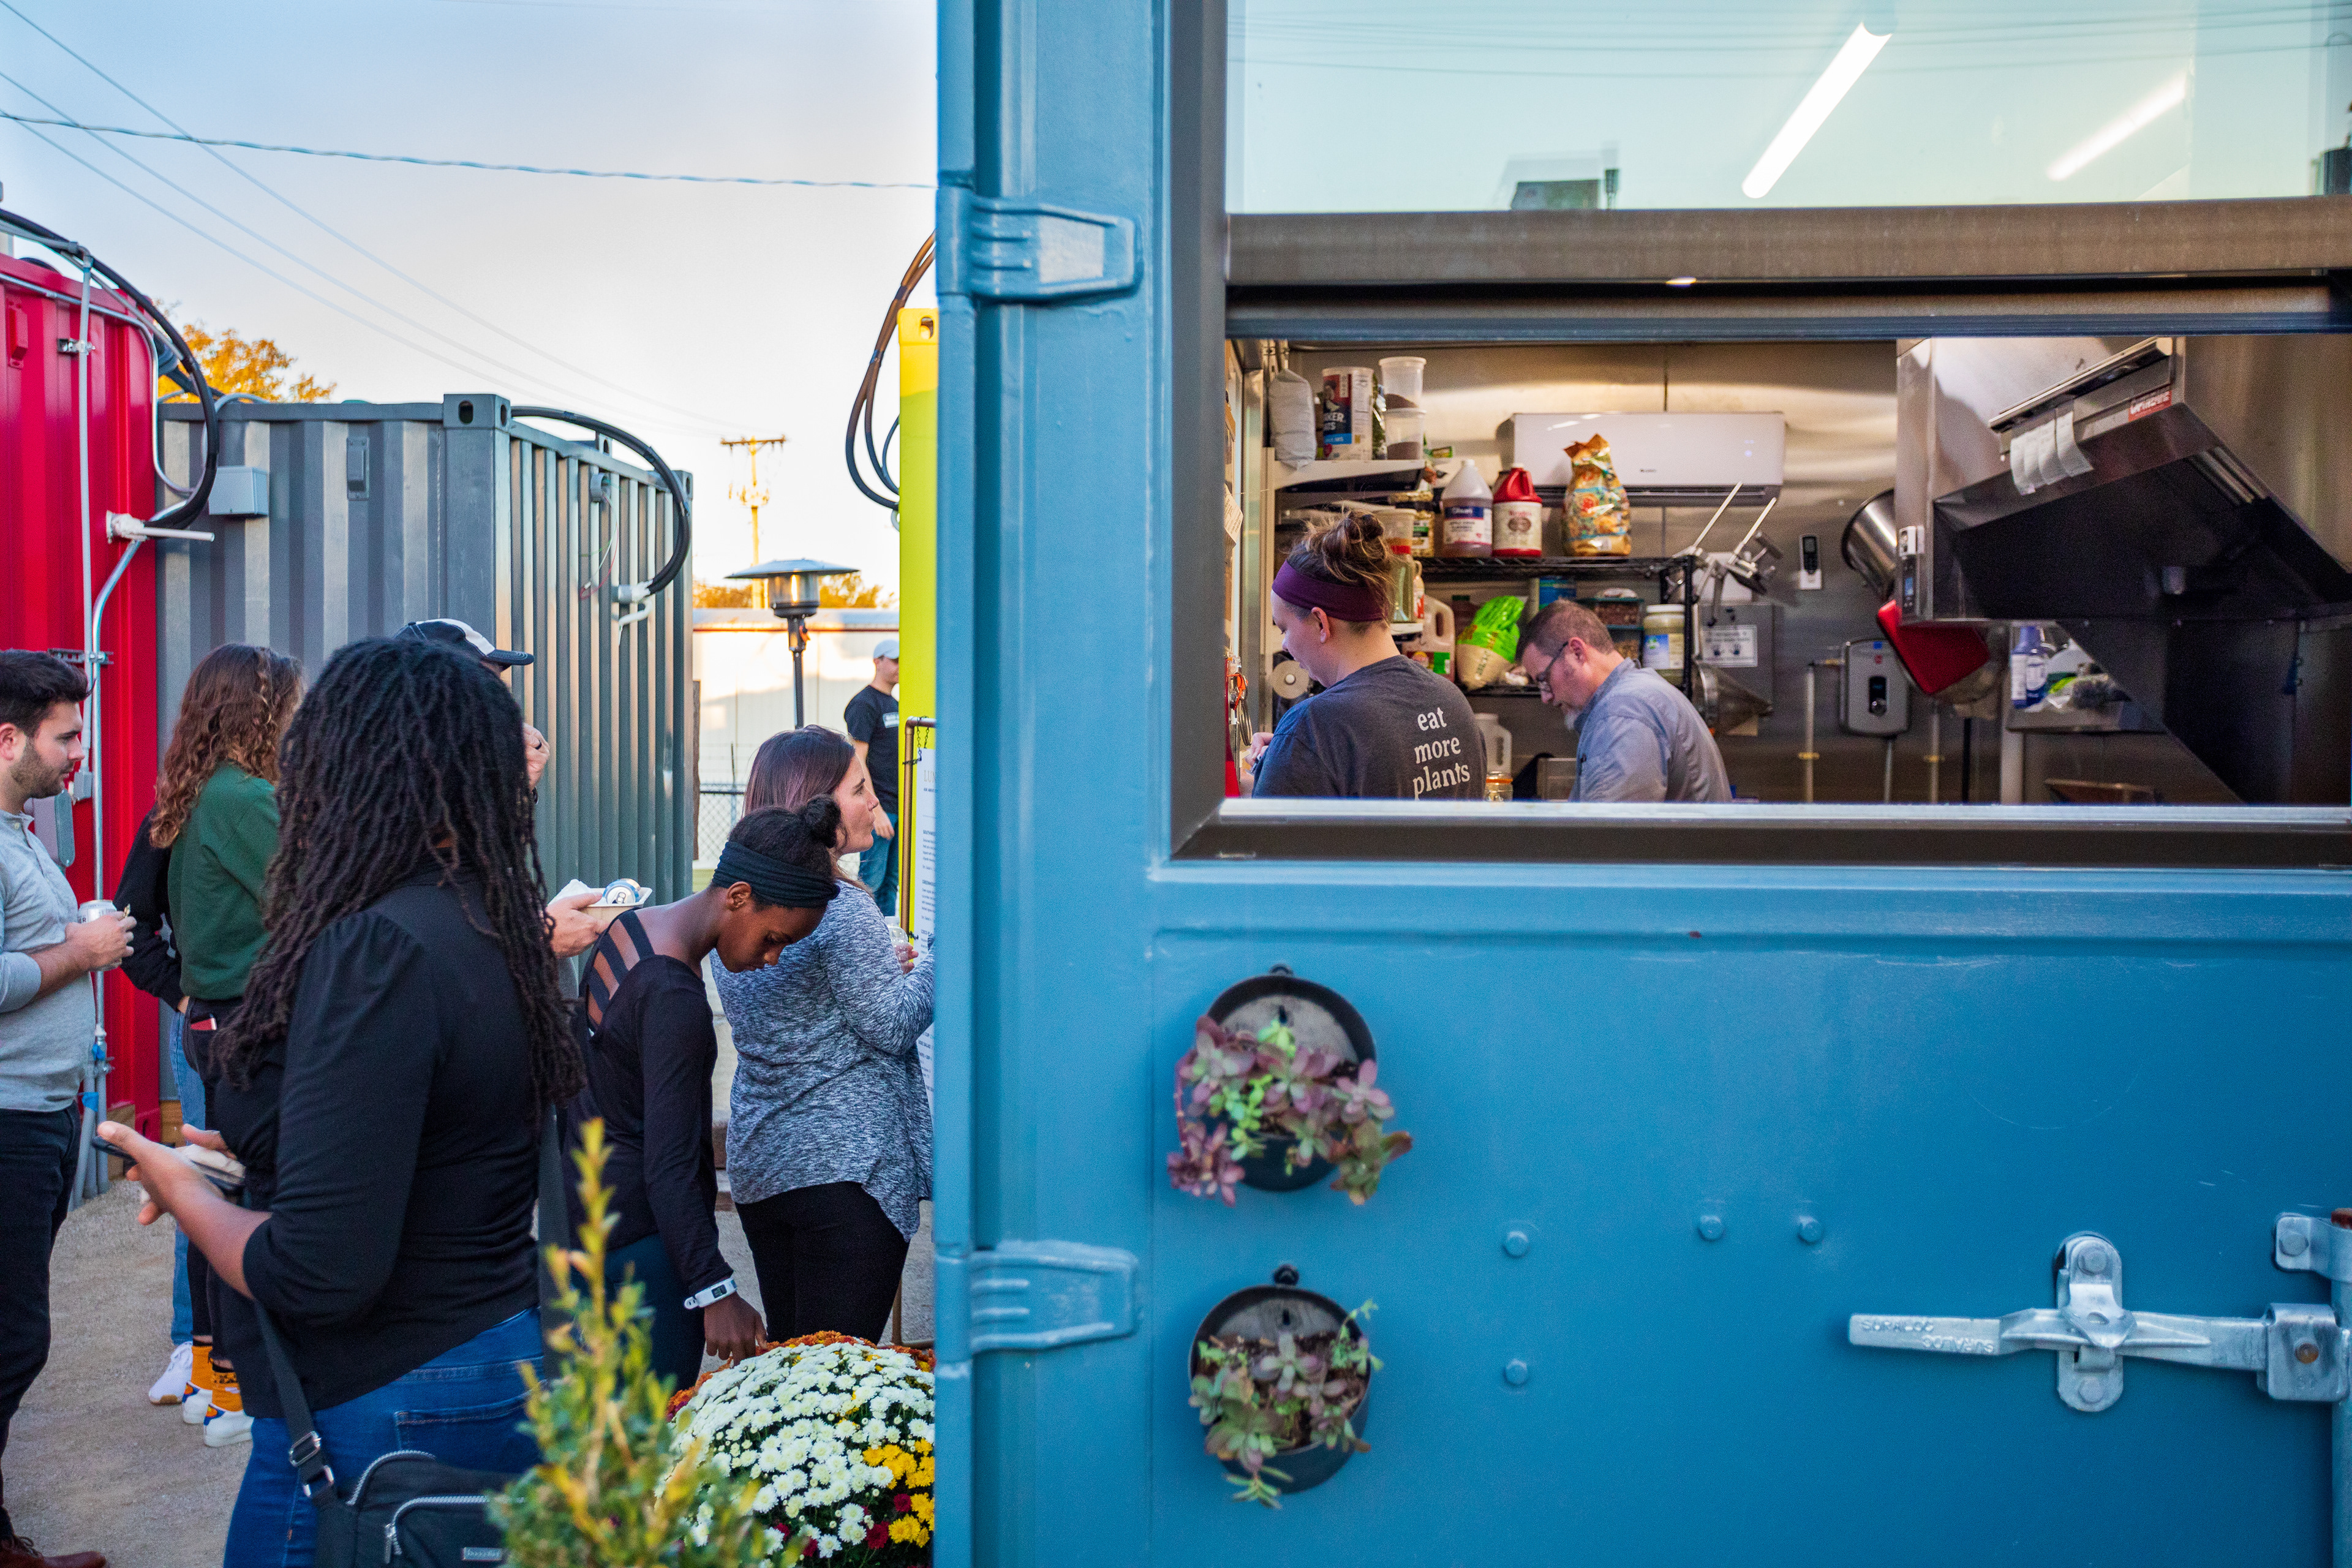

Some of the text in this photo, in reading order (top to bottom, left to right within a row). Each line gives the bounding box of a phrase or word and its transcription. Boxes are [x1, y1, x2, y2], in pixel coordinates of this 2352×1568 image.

[1417, 707, 1447, 731] eat
[1414, 737, 1461, 764] more
[1412, 763, 1471, 801] plants
